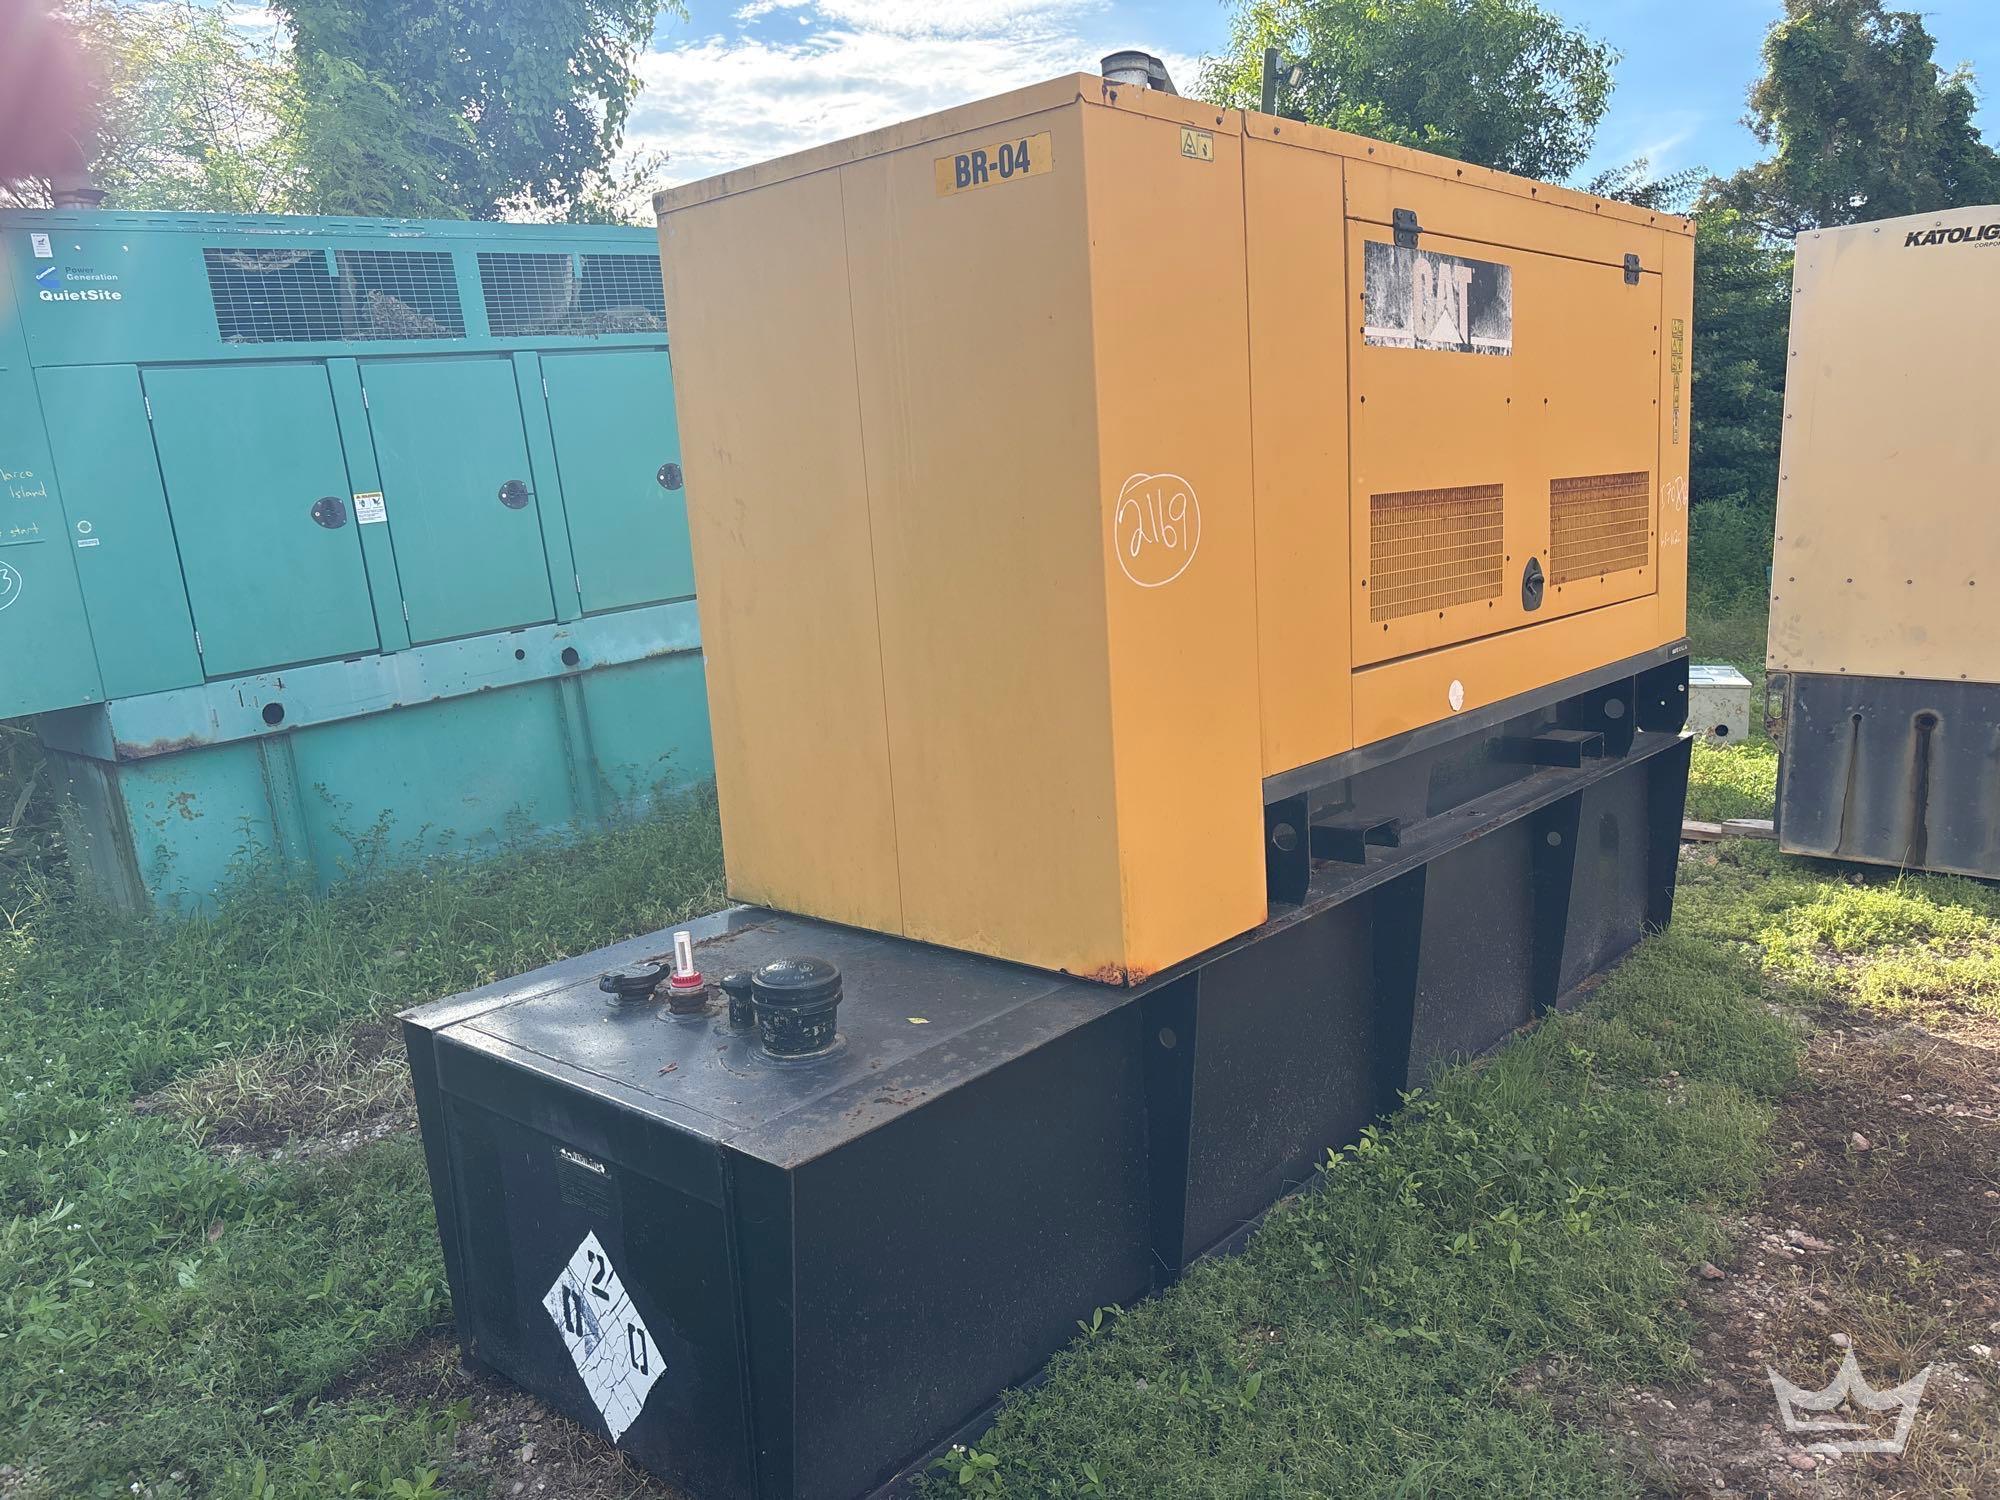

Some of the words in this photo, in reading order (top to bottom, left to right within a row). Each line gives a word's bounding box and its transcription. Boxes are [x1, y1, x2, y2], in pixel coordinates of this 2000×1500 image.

[955, 139, 1031, 189] BR-04
[1903, 223, 2000, 248] KATOLIG
[65, 266, 95, 274] Power
[66, 273, 119, 281] Generation
[39, 289, 122, 302] QuietSite
[1412, 257, 1473, 345] CAT
[9, 481, 47, 499] Island
[1119, 488, 1187, 557] 2169
[587, 1249, 610, 1301] 2
